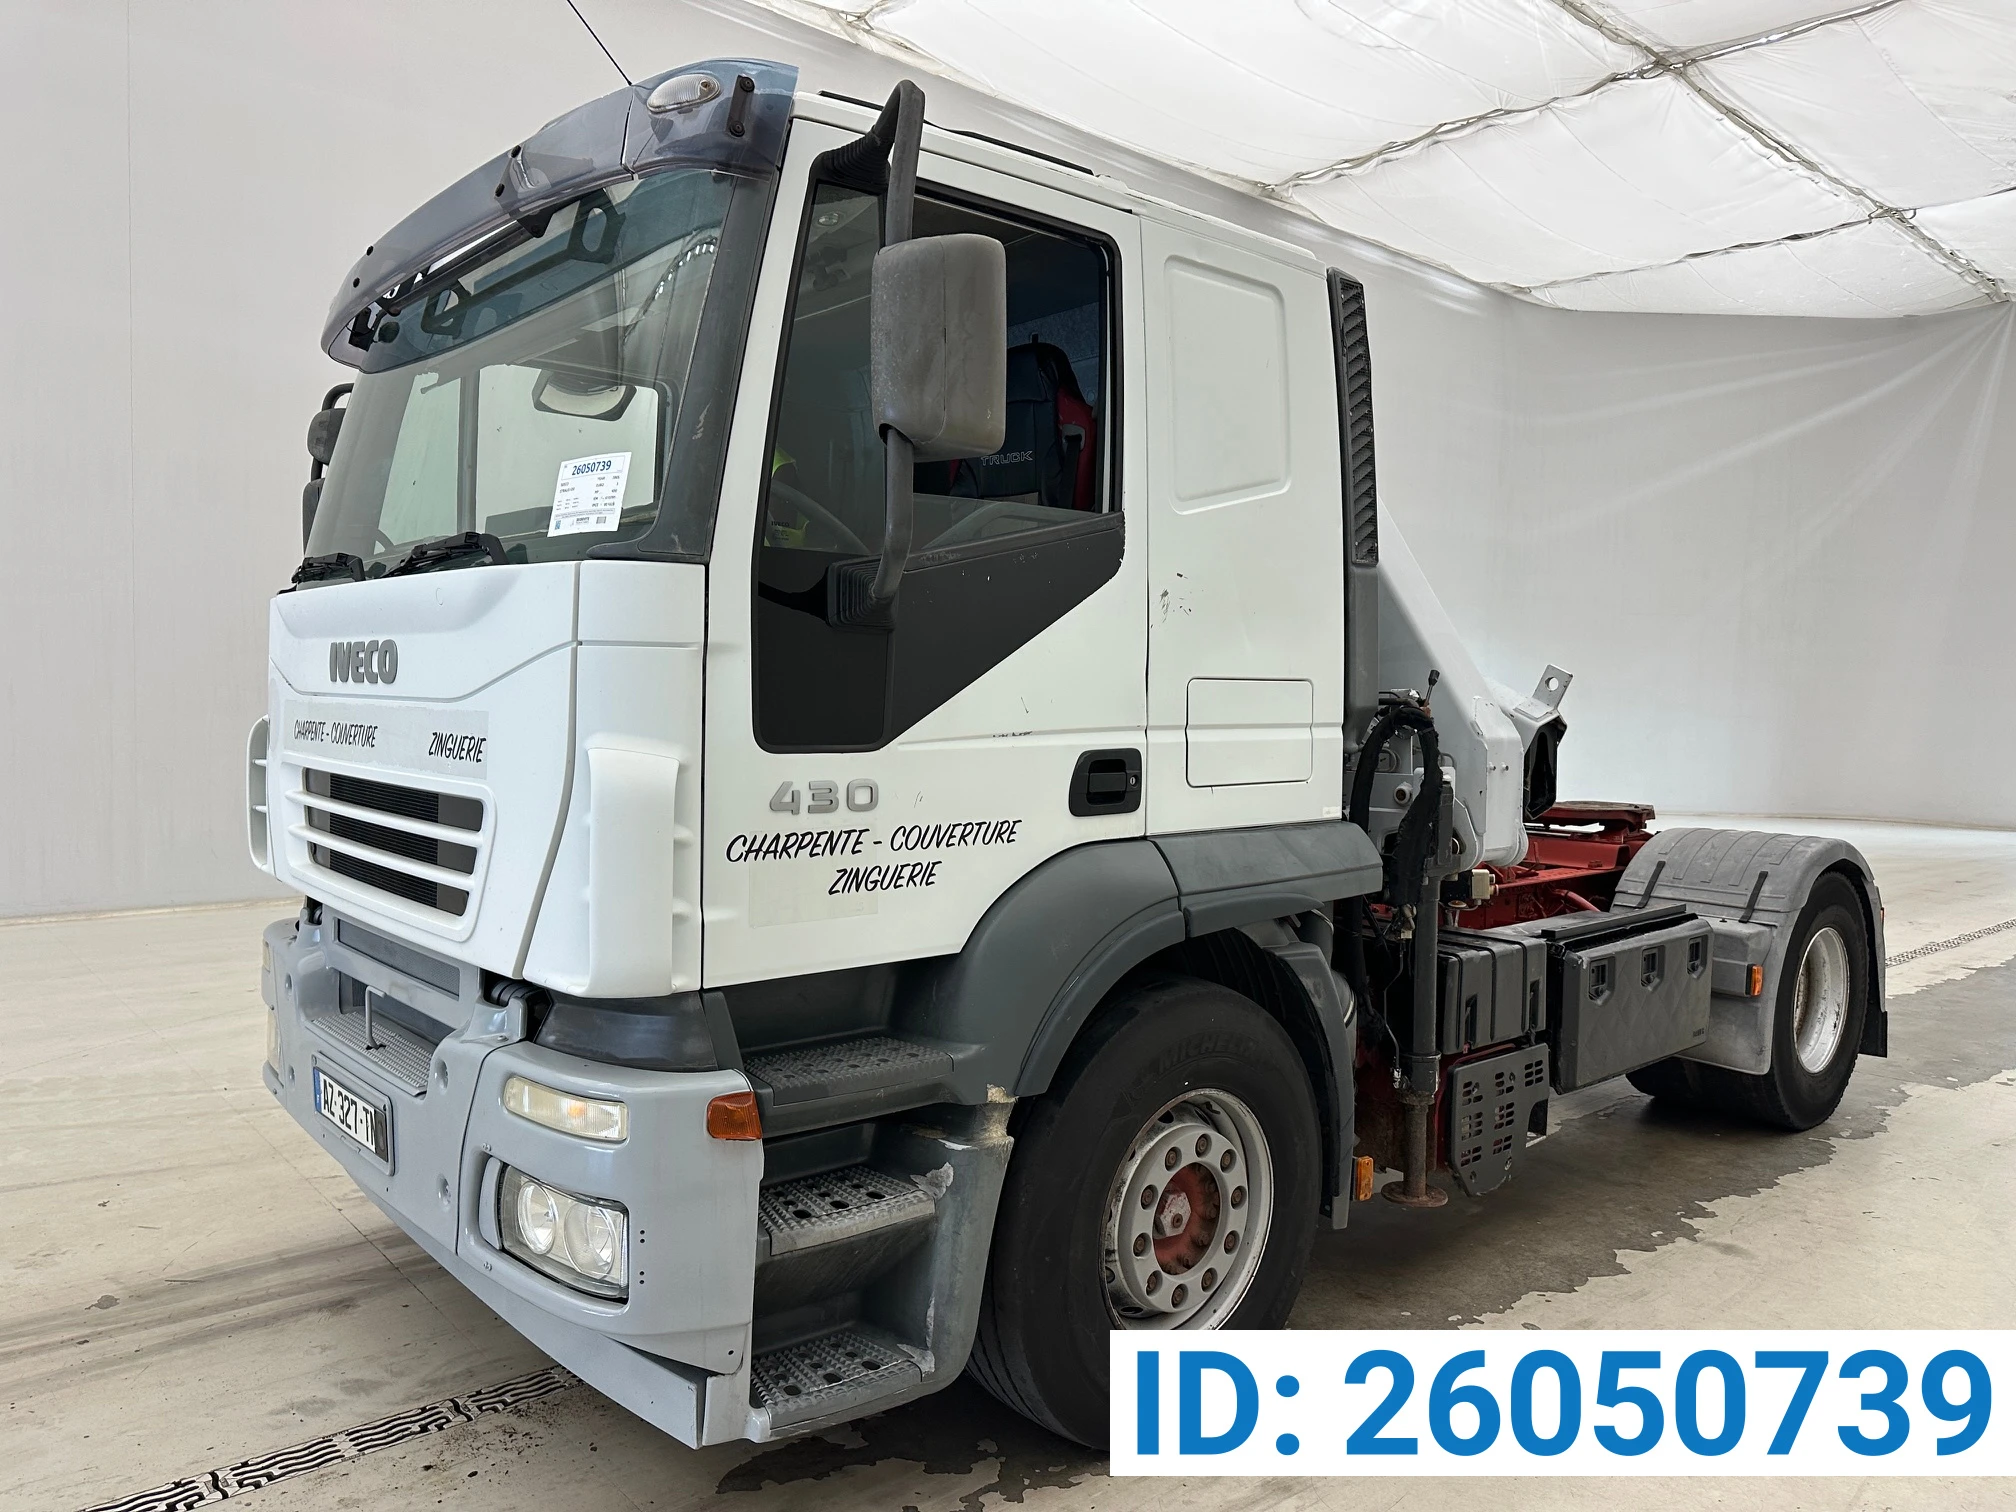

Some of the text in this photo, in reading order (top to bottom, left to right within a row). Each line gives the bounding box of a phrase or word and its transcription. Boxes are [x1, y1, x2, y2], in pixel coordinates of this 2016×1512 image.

[571, 460, 612, 475] 26050739
[981, 450, 1033, 466] TRUCK
[329, 639, 398, 684] IVECO
[294, 719, 327, 743] CHARPENTE
[330, 722, 378, 748] COUVERTURE
[428, 731, 487, 763] ZINGUERIE
[769, 778, 879, 815] 430
[725, 828, 870, 863] CHARPENTE
[890, 819, 1022, 851] COUVERTURE
[827, 860, 942, 896] ZINGUERIE
